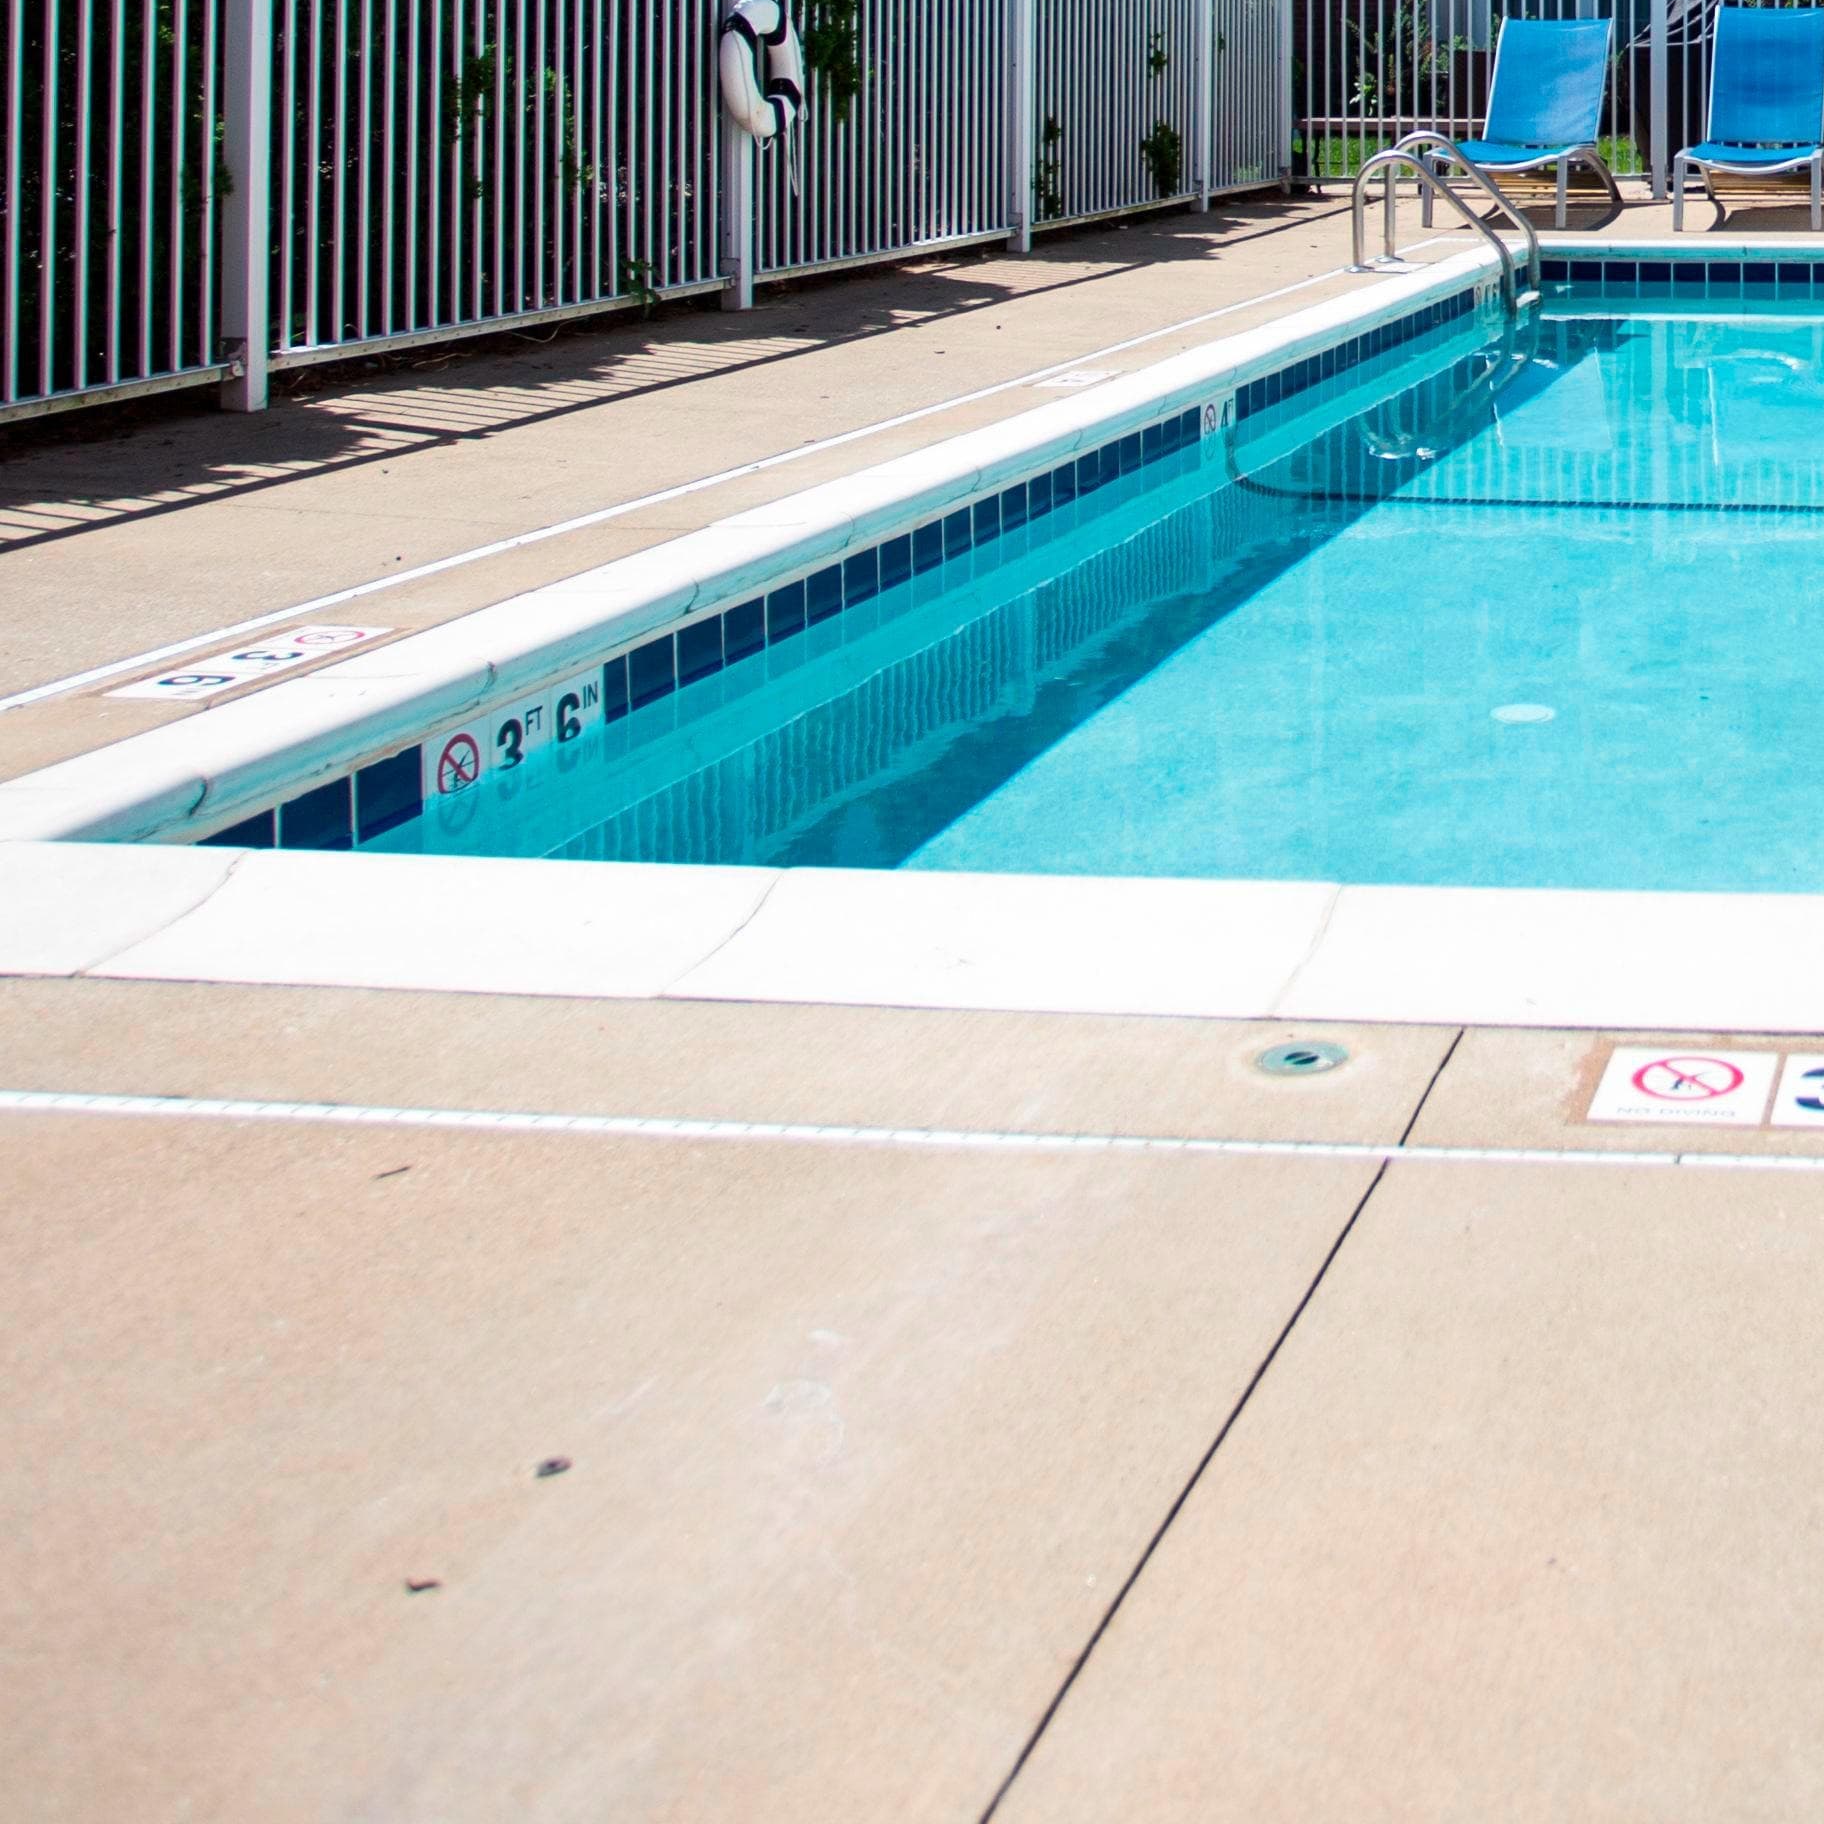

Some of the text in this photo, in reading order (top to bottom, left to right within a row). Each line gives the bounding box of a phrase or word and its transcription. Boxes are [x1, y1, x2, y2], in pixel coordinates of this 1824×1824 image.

[231, 650, 304, 661] 3
[157, 674, 236, 686] 6
[497, 681, 598, 771] 3 FT 6 IN
[1617, 1106, 1651, 1115] NO
